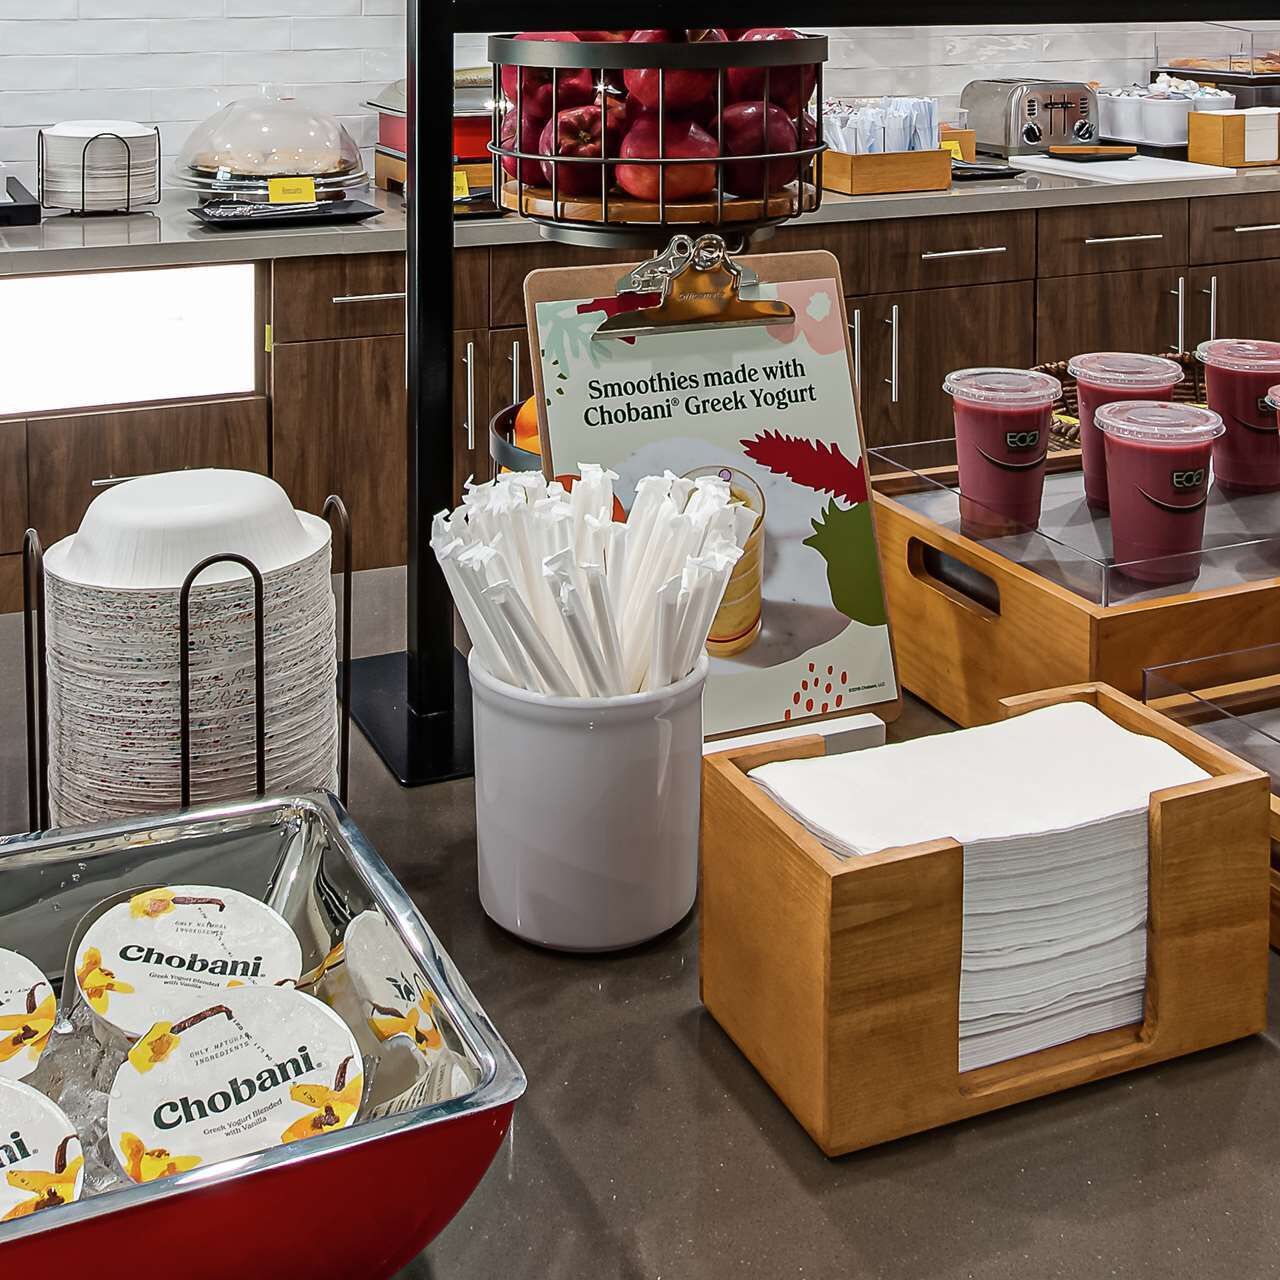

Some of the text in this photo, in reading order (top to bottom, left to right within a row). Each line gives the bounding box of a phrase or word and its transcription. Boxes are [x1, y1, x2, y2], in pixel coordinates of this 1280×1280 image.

[588, 357, 807, 401] Smoothies made with
[684, 389, 748, 416] Greek
[749, 383, 818, 411] Yogurt
[118, 944, 263, 978] Chobani
[170, 973, 193, 984] Yogurt
[194, 1040, 250, 1067] INGREDIENTS
[152, 1045, 317, 1131] Chobani
[203, 1123, 227, 1136] Greek
[226, 1112, 253, 1130] Yogurt
[252, 1097, 284, 1119] Blended
[224, 1114, 268, 1138] with Vanilla
